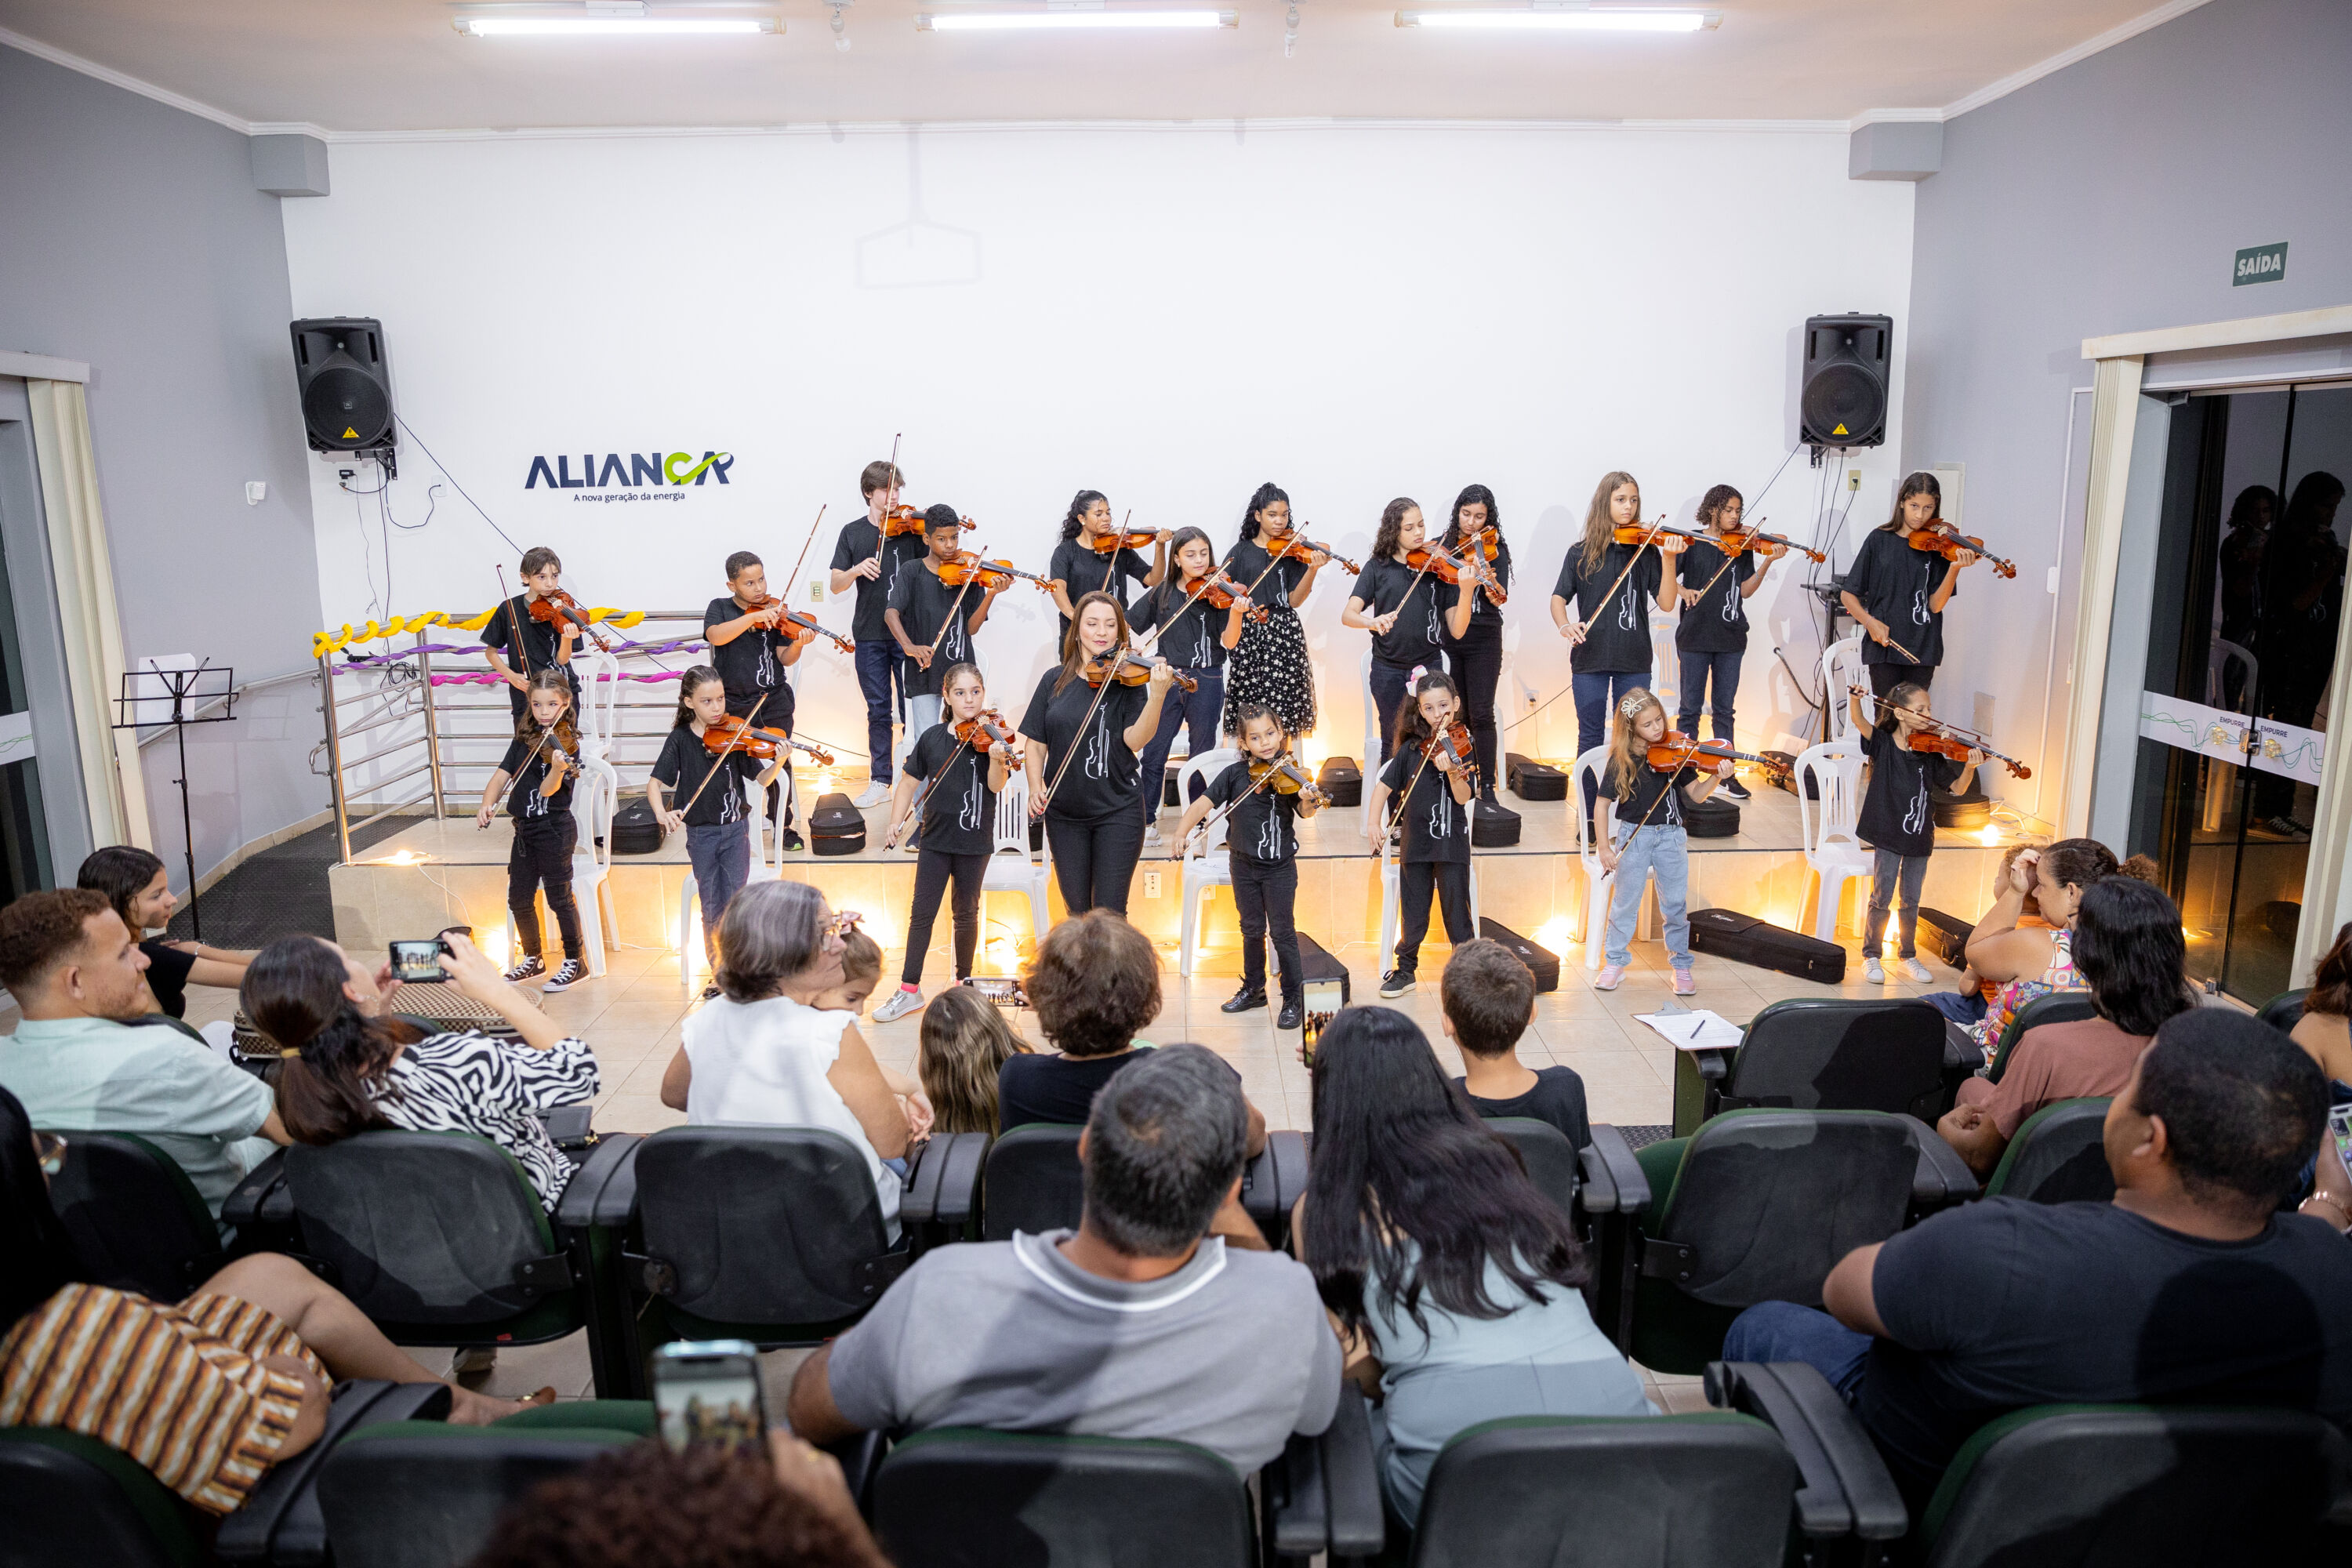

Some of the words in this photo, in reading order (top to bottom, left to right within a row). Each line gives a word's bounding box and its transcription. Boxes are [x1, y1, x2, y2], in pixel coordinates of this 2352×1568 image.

[2237, 252, 2281, 277] SAÍDA
[524, 451, 735, 489] ALIANÇA
[604, 492, 638, 503] geração
[641, 492, 652, 500] da
[653, 491, 685, 502] energia
[2220, 716, 2245, 728] EMPURRE
[2260, 725, 2288, 738] EMPURRE
